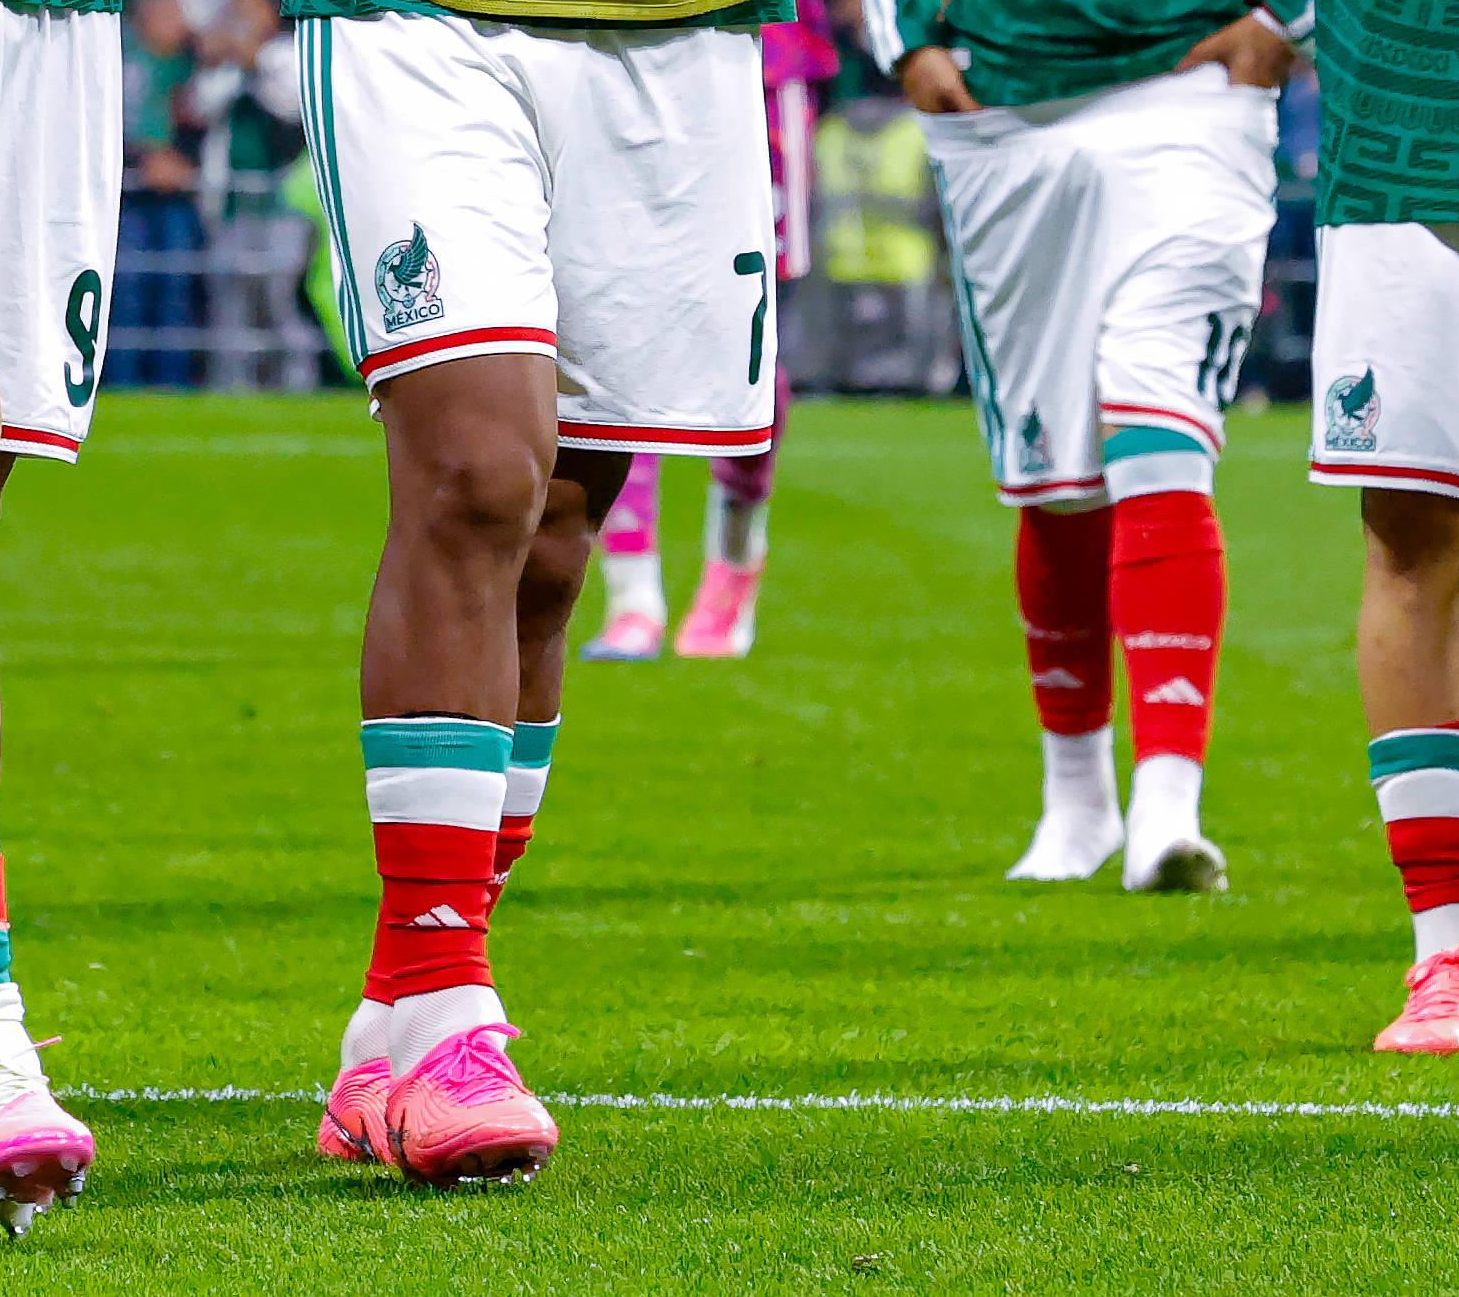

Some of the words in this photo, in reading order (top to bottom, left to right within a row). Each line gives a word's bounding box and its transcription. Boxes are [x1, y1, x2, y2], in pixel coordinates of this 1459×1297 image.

[63, 268, 103, 408] 9
[386, 301, 442, 328] MÉXICO
[733, 251, 767, 386] 7
